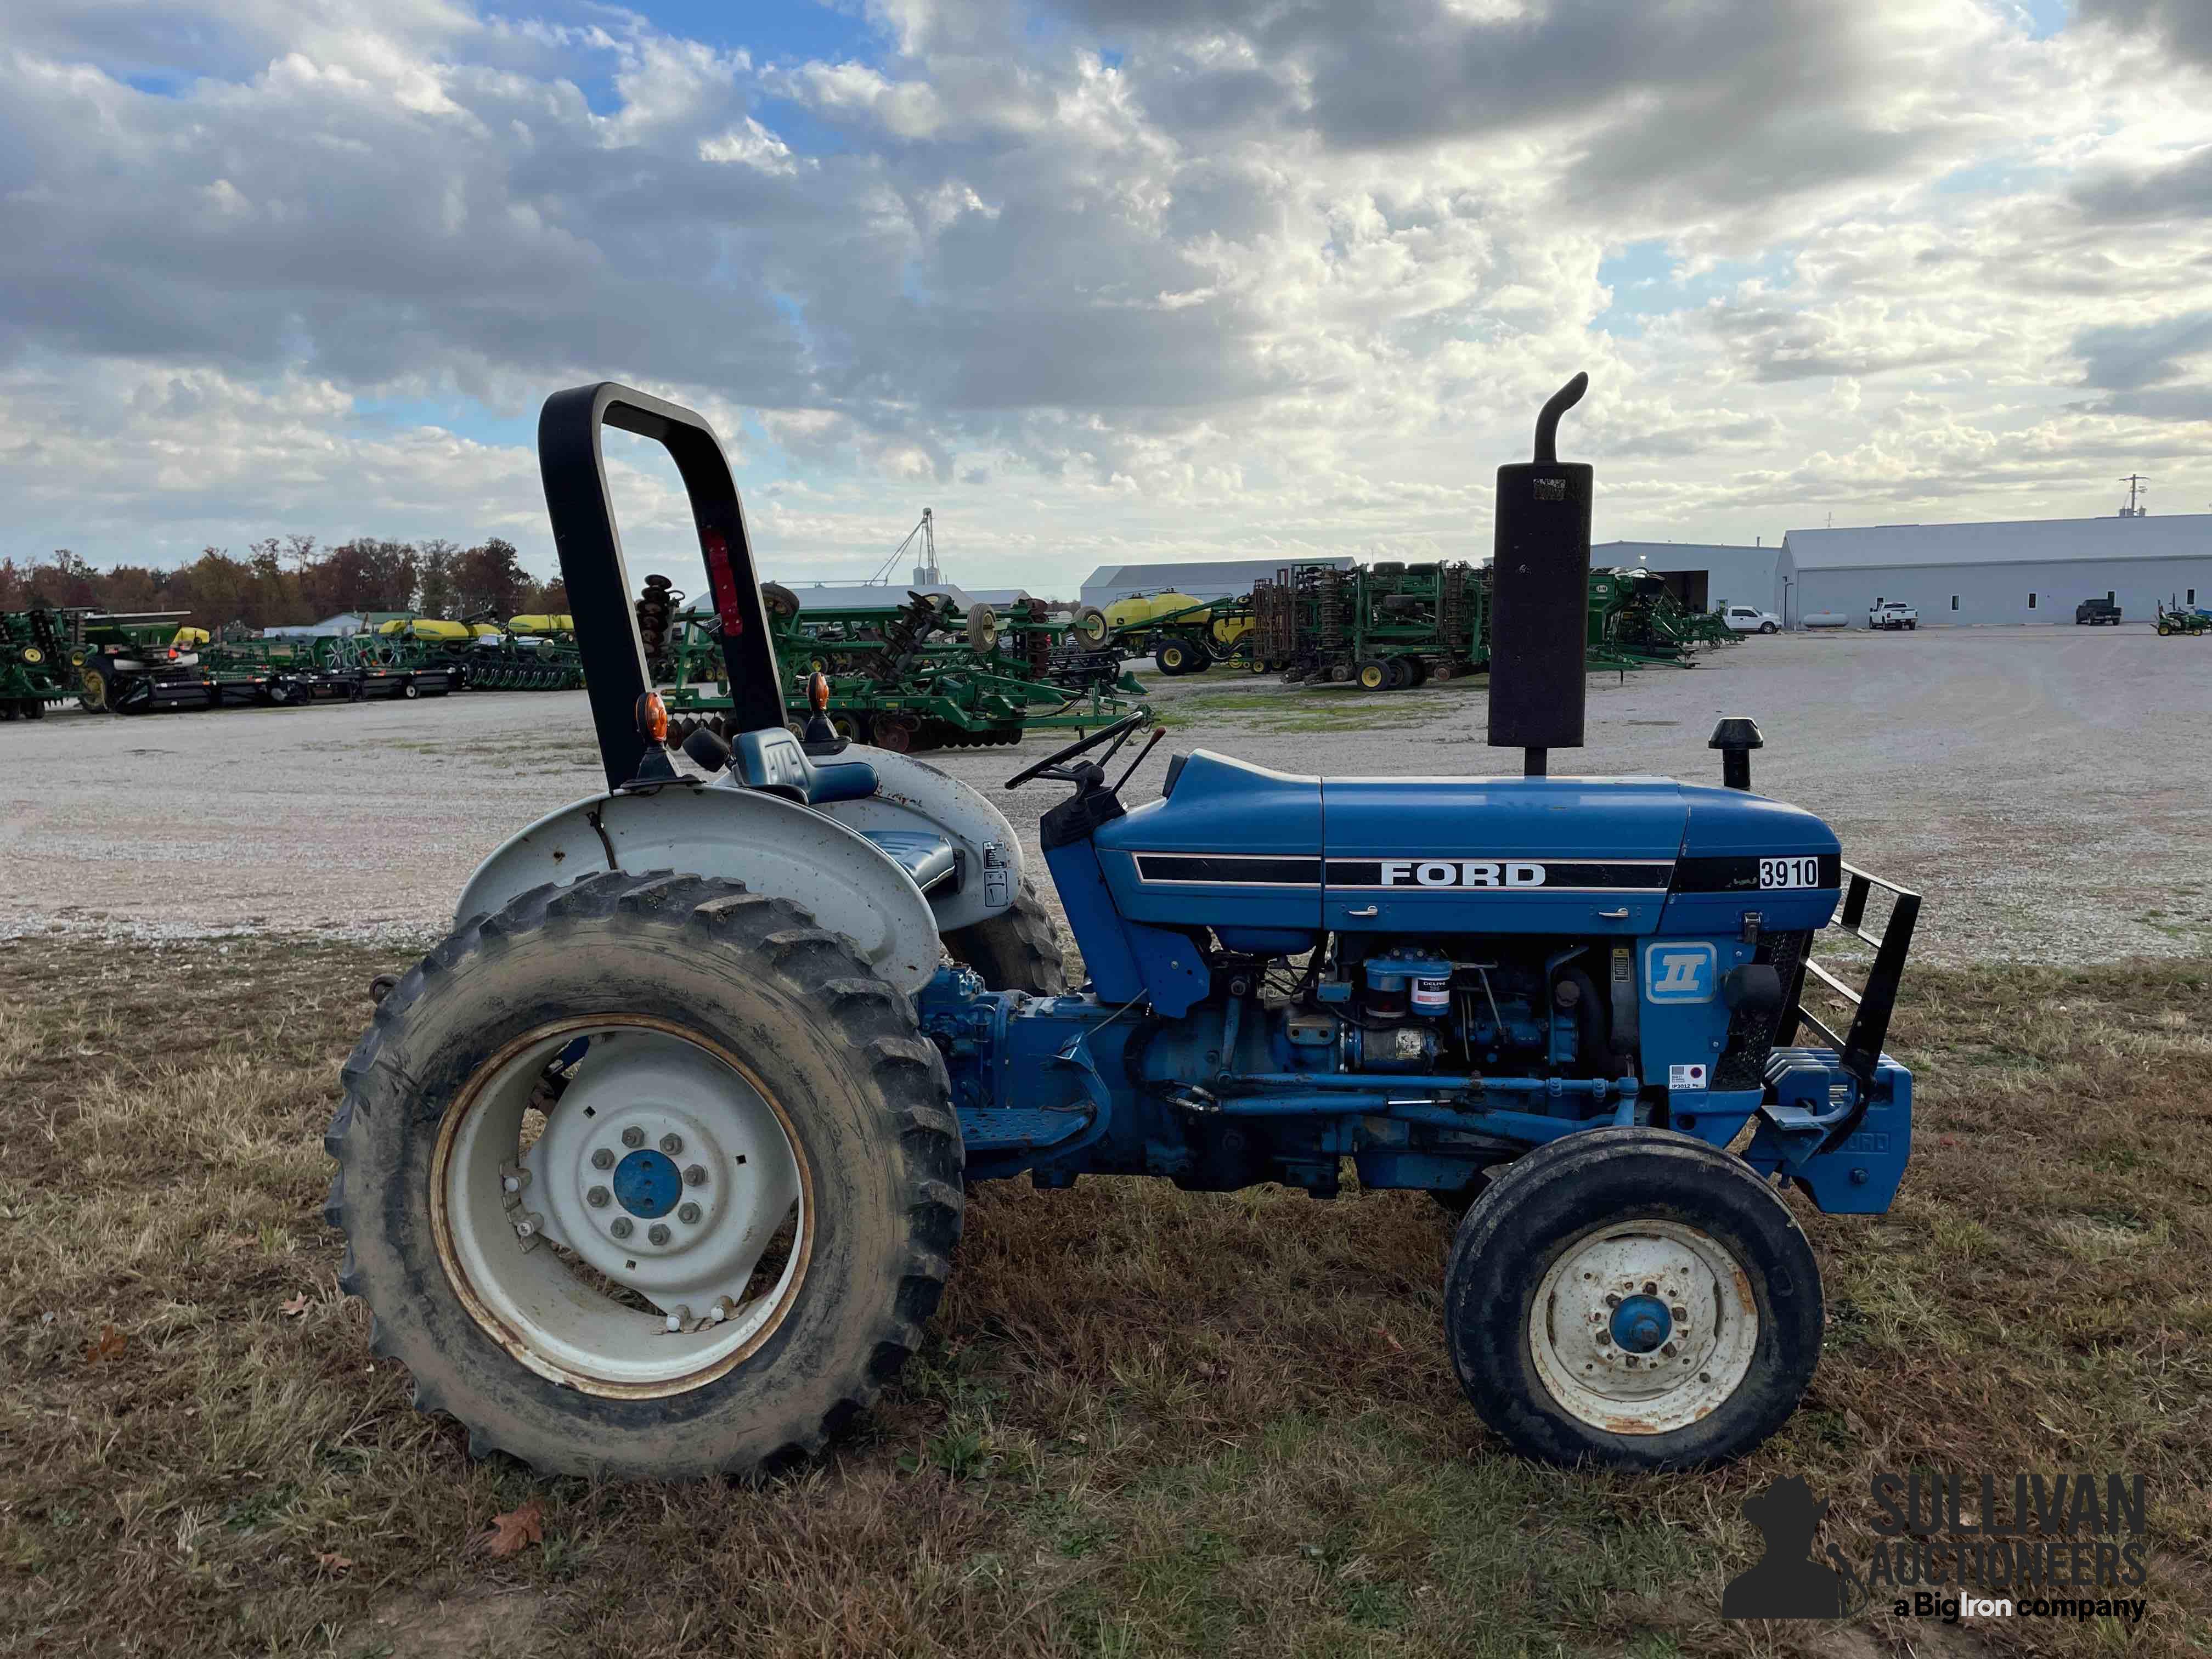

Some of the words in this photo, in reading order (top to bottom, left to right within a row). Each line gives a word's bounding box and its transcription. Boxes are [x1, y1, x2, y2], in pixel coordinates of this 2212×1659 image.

[1381, 862, 1545, 886] FORD
[1761, 860, 1817, 887] 3910
[1655, 954, 1707, 991] II
